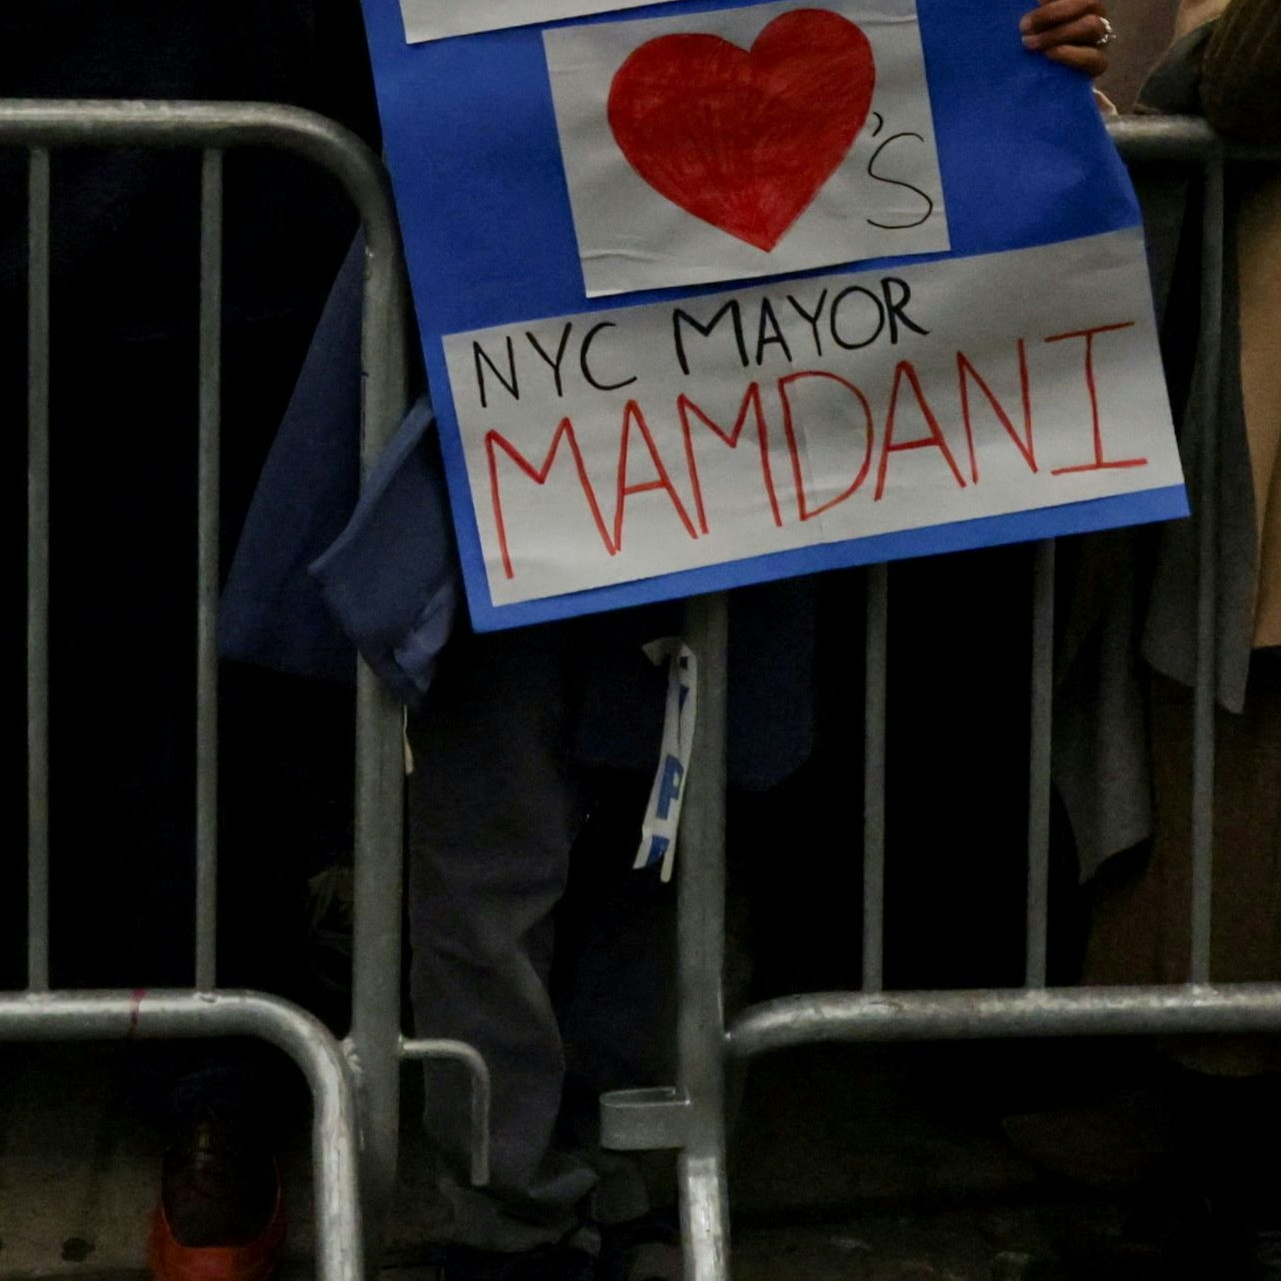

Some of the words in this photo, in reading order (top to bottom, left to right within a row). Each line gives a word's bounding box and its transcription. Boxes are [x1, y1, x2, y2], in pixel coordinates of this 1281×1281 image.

[473, 322, 636, 408] NYC
[672, 277, 929, 375] MAYOR
[485, 322, 1148, 579] MAMDANI
